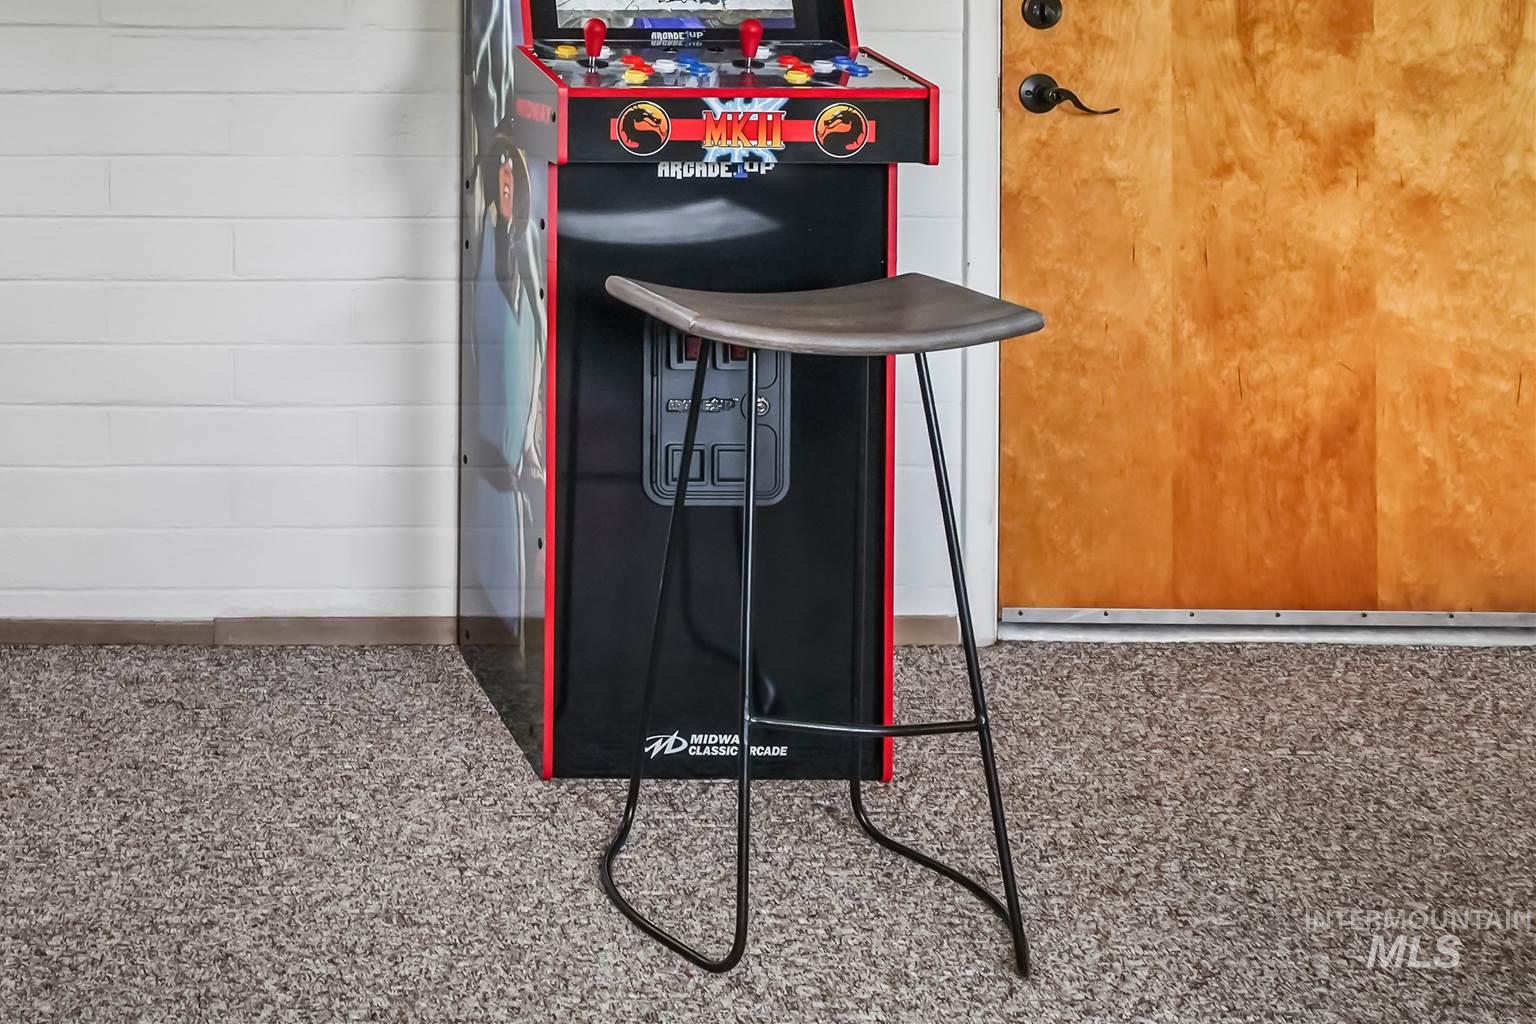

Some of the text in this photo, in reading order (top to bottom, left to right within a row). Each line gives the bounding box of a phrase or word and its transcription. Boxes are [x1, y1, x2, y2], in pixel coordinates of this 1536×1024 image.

[689, 733, 741, 745] MIDWA
[688, 745, 788, 757] CLASSIC RCADE
